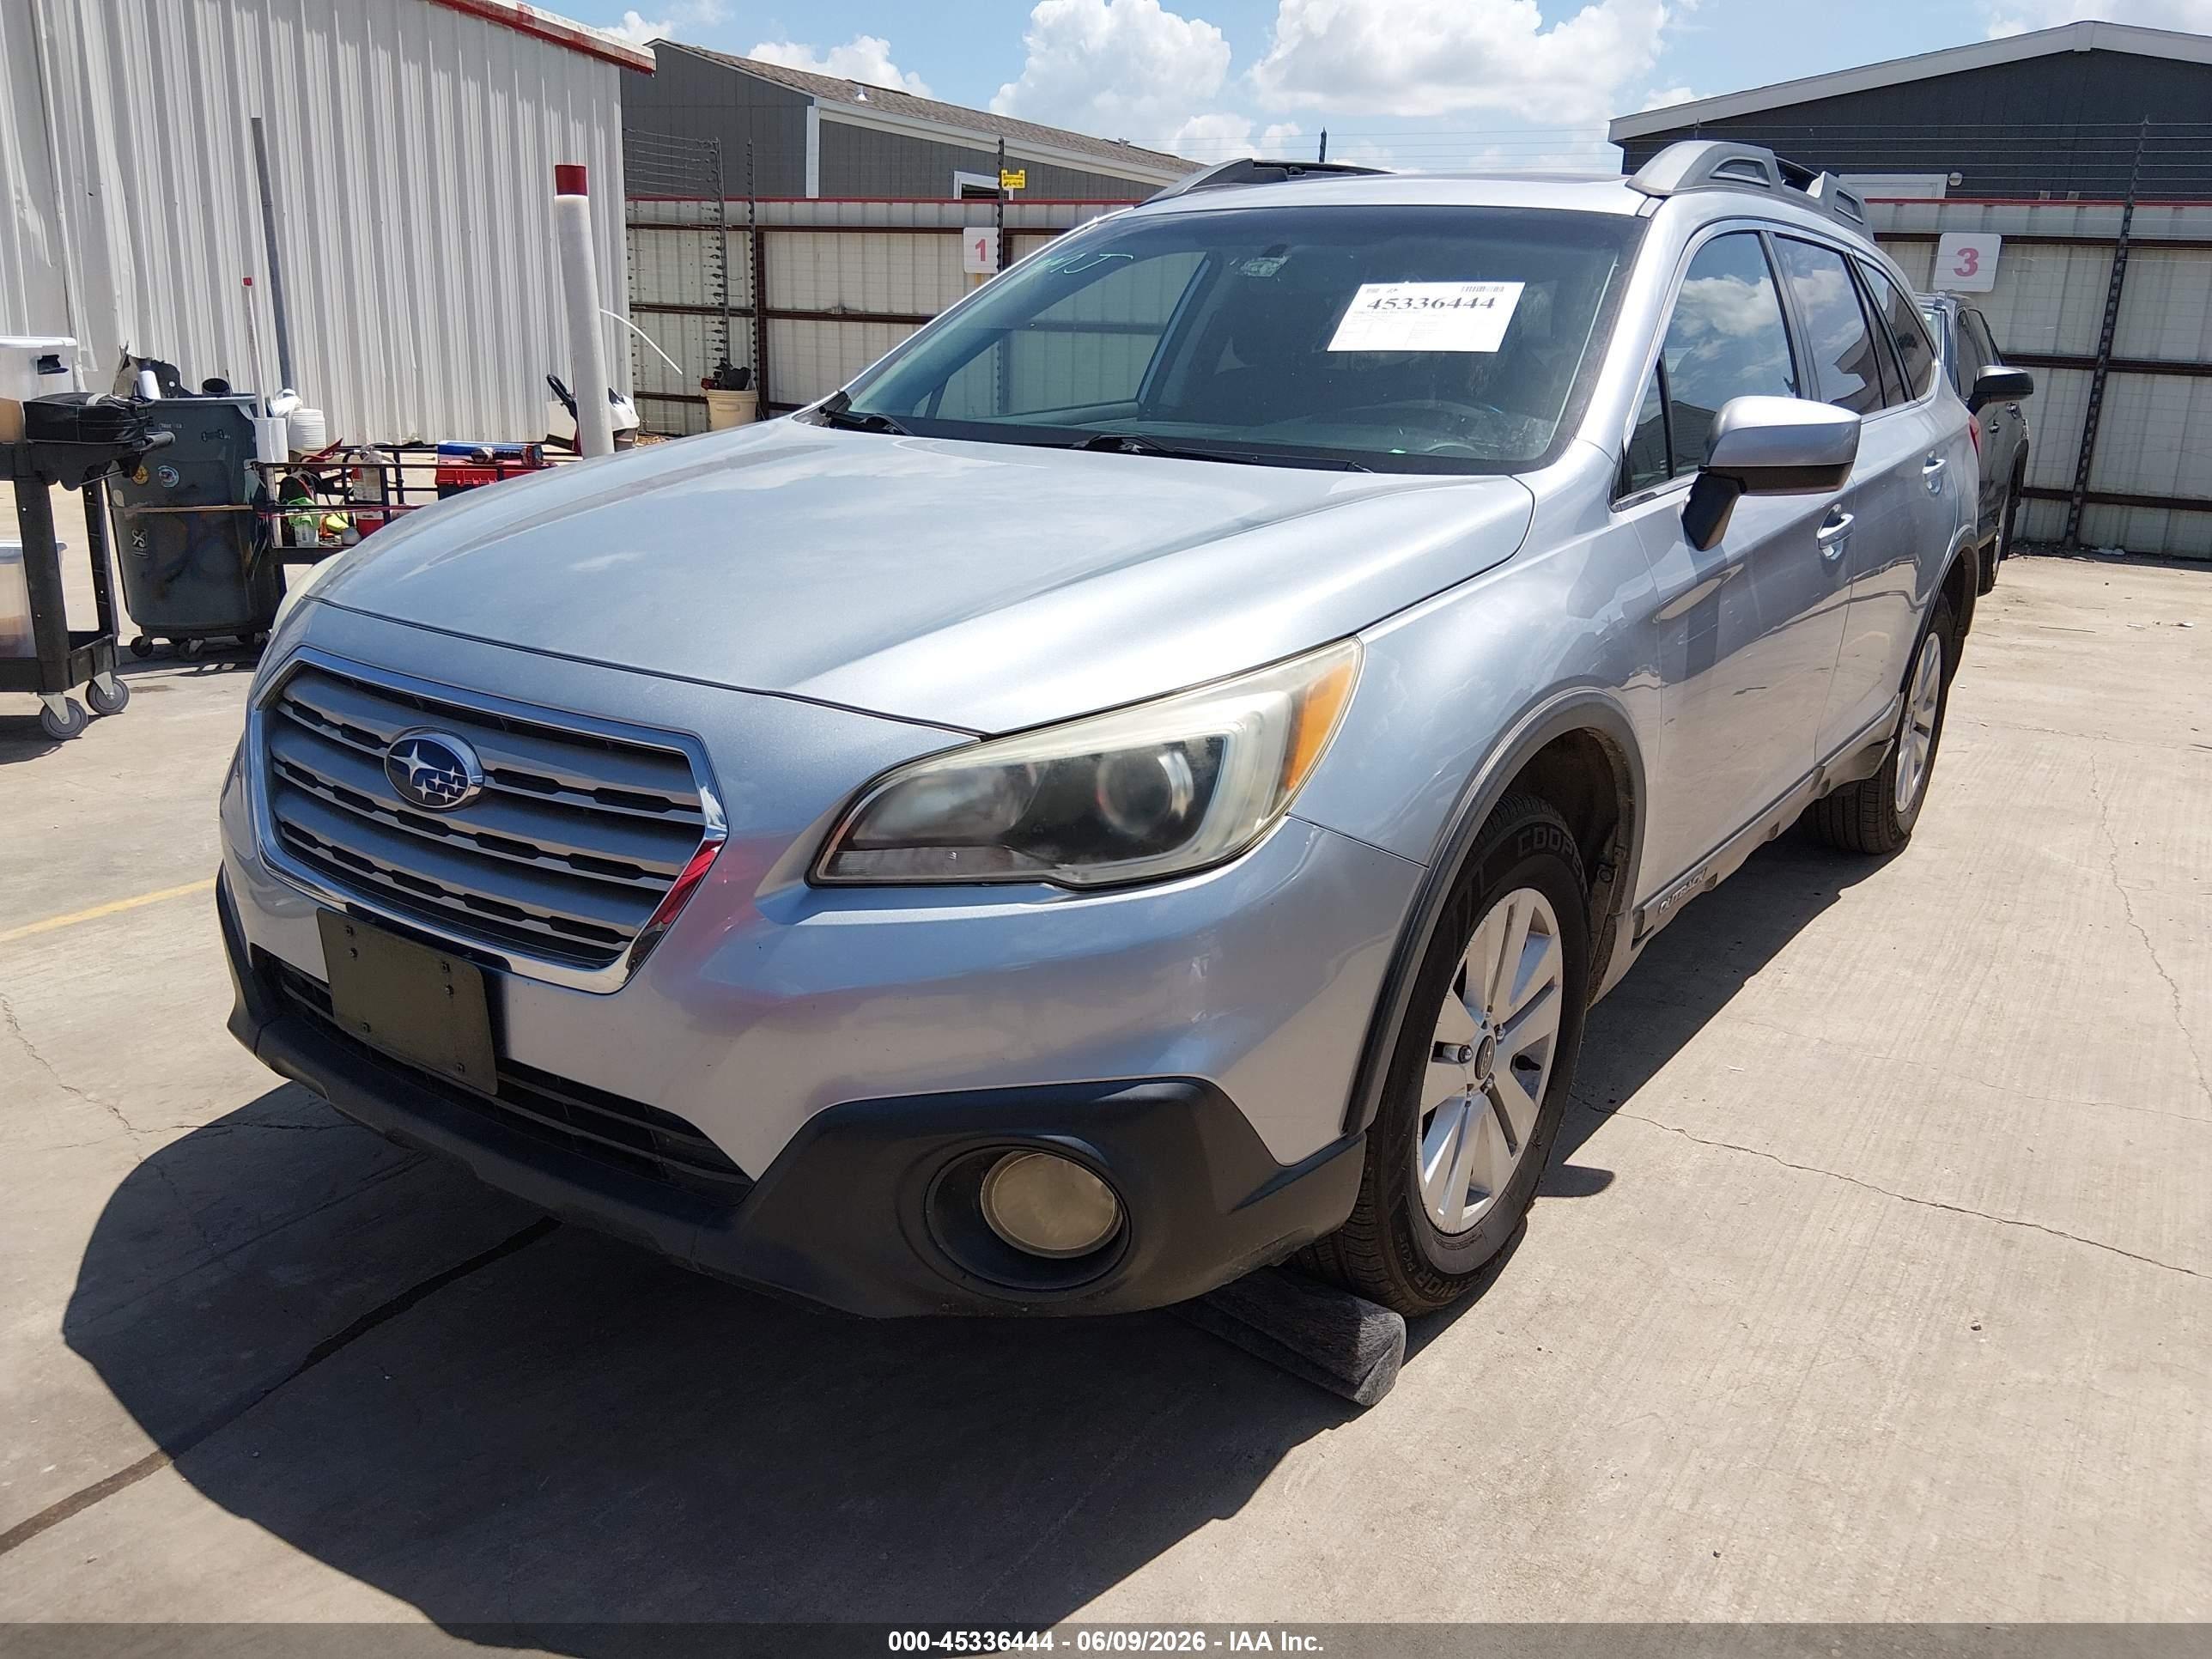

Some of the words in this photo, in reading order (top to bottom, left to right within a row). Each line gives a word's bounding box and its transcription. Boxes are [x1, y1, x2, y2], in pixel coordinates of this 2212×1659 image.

[975, 238, 988, 262] 1
[1953, 247, 1979, 277] 3
[1366, 295, 1497, 310] 45336444
